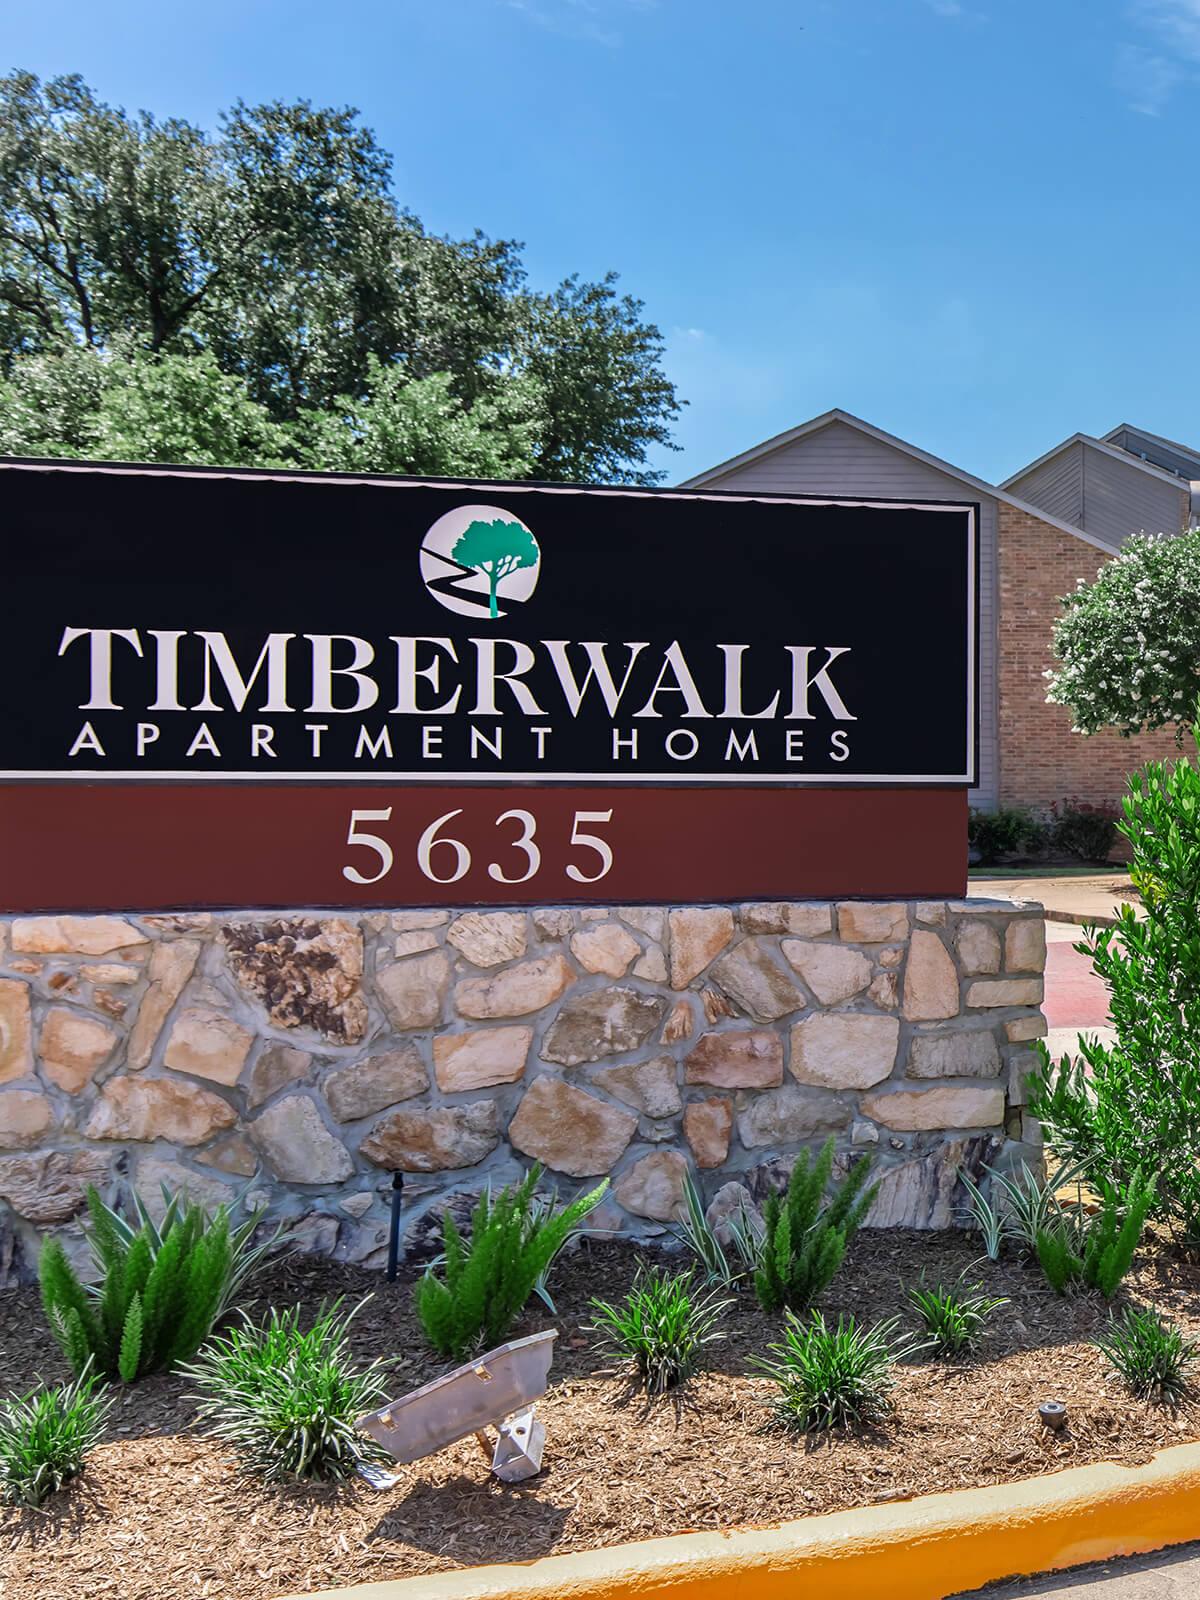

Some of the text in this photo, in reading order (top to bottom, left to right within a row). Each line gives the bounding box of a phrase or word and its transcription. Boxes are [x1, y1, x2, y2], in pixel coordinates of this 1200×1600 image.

[58, 626, 858, 720] TIMBERWALK
[68, 721, 850, 762] APARTMENT HOMES
[342, 806, 613, 884] 5635
